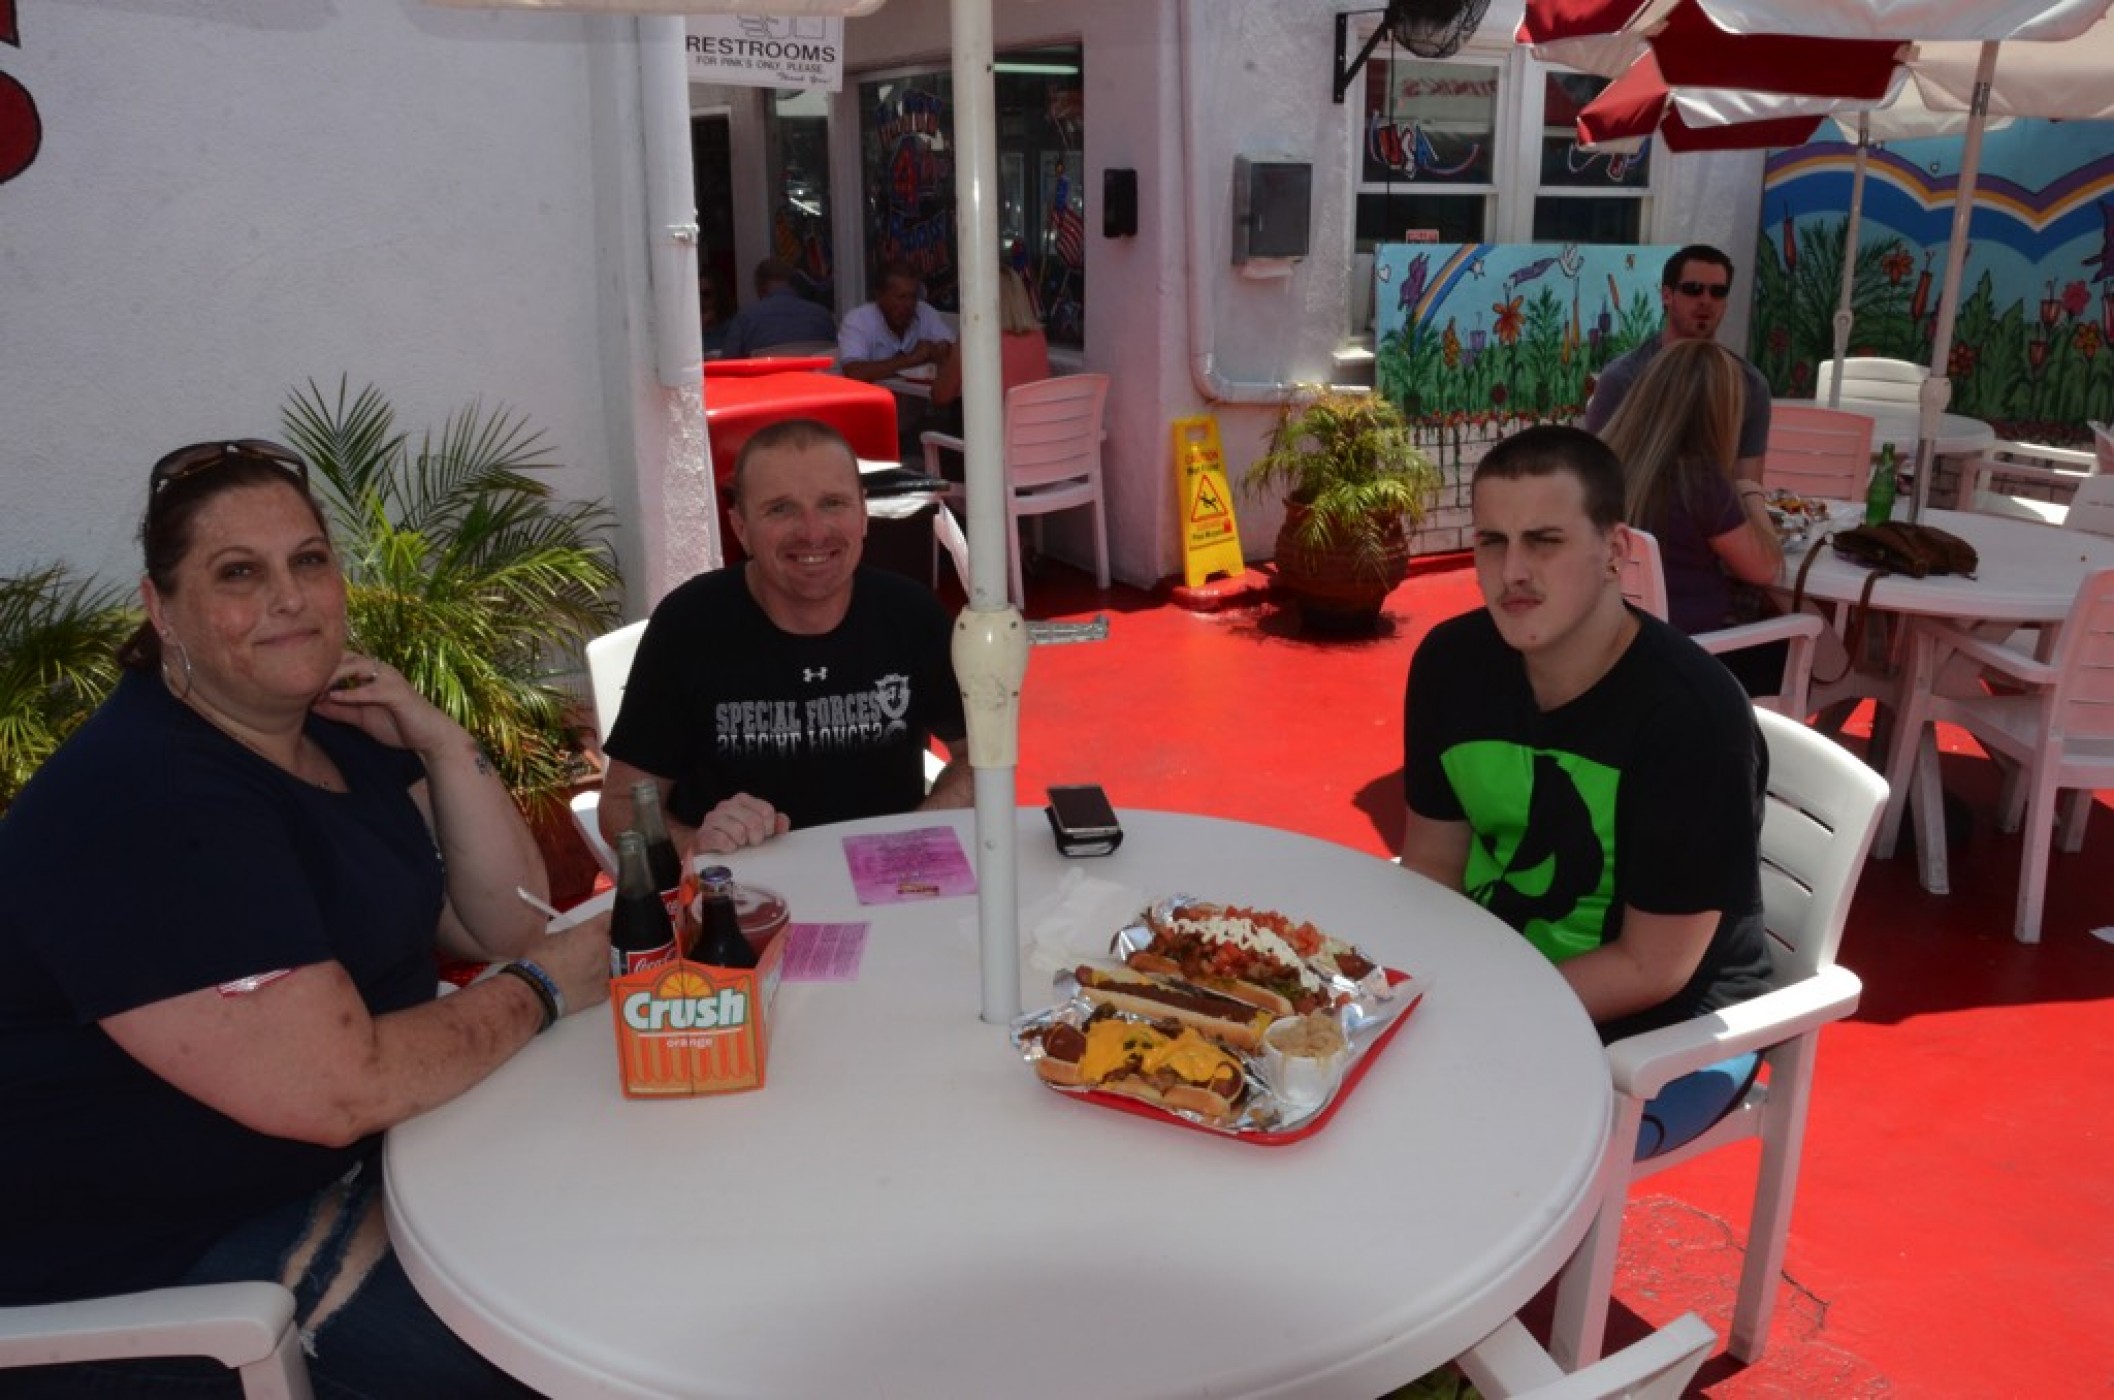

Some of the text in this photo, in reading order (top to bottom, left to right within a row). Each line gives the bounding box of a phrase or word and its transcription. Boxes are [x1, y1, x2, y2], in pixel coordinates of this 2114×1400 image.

[685, 34, 836, 63] RESTROOMS
[696, 55, 717, 66] FOR
[716, 691, 882, 734] SPECIAL FORCES
[623, 989, 746, 1030] Crush
[666, 1038, 713, 1050] orange
